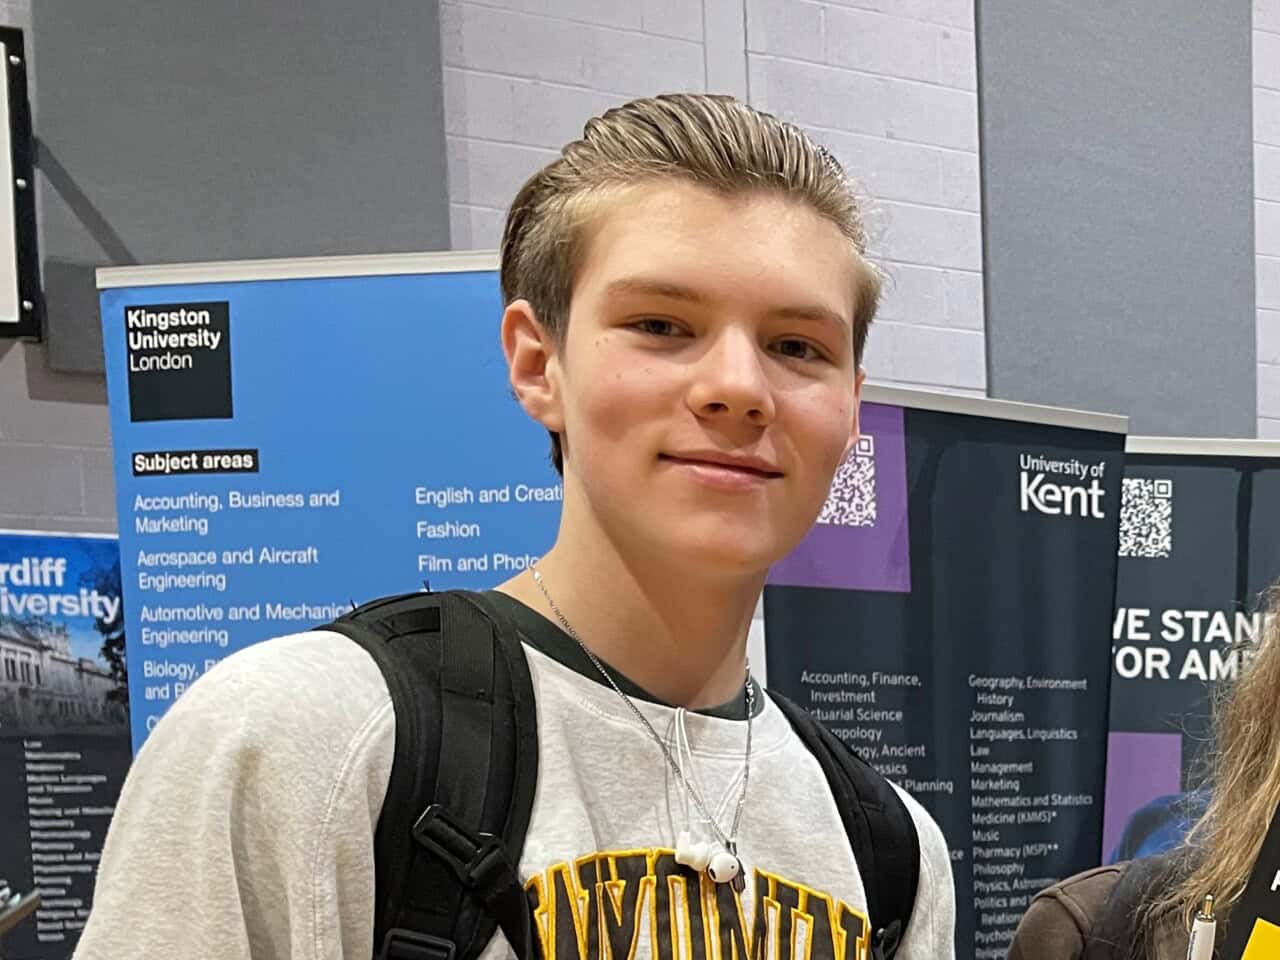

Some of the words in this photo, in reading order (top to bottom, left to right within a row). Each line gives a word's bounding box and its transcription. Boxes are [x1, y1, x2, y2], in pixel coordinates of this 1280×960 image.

[127, 309, 210, 330] Kingston
[128, 330, 221, 350] University
[130, 352, 192, 372] London
[134, 452, 198, 473] Subject
[202, 454, 254, 468] areas
[1020, 454, 1088, 480] University
[1090, 462, 1106, 478] of
[134, 492, 223, 512] Accounting,
[229, 491, 304, 508] Business
[309, 490, 340, 506] and
[416, 486, 473, 508] English
[480, 486, 510, 502] and
[1020, 472, 1106, 518] Kent
[136, 516, 208, 536] Marketing
[416, 521, 480, 538] Fashion
[138, 550, 217, 568] Aerospace
[222, 548, 254, 564] and
[258, 546, 318, 564] Aircraft
[418, 554, 452, 572] Film
[458, 554, 488, 571] and
[138, 572, 226, 592] Engineering
[140, 604, 224, 622] Automotive
[229, 603, 260, 620] and
[1113, 608, 1150, 641] E
[1160, 610, 1275, 644] STAN
[142, 628, 228, 648] Engineering
[144, 660, 200, 678] Biology,
[1112, 645, 1171, 679] OR
[1178, 648, 1253, 681] AM
[800, 671, 870, 686] Accounting,
[872, 672, 922, 688] Finance,
[968, 674, 1025, 690] Geography,
[1026, 676, 1088, 690] Environment
[145, 683, 169, 700] and
[811, 690, 876, 703] Investment
[977, 692, 1014, 707] History
[804, 706, 853, 720] ctuarial
[856, 708, 903, 721] Science
[970, 710, 1024, 722] Journalism
[1027, 728, 1078, 742] Linguistics
[881, 744, 926, 757] Ancient
[970, 744, 990, 756] Law
[971, 762, 1033, 776] Management
[905, 780, 953, 793] Planning
[971, 778, 1020, 792] Marketing
[972, 796, 1032, 808] Mathematics
[972, 812, 1015, 824] Medicine
[972, 830, 1000, 842] Music
[973, 846, 1020, 860] Pharmacy
[974, 862, 1024, 876] Philosophy
[974, 880, 1011, 894] Physics,
[974, 896, 1007, 910] Politics
[1010, 896, 1027, 908] and
